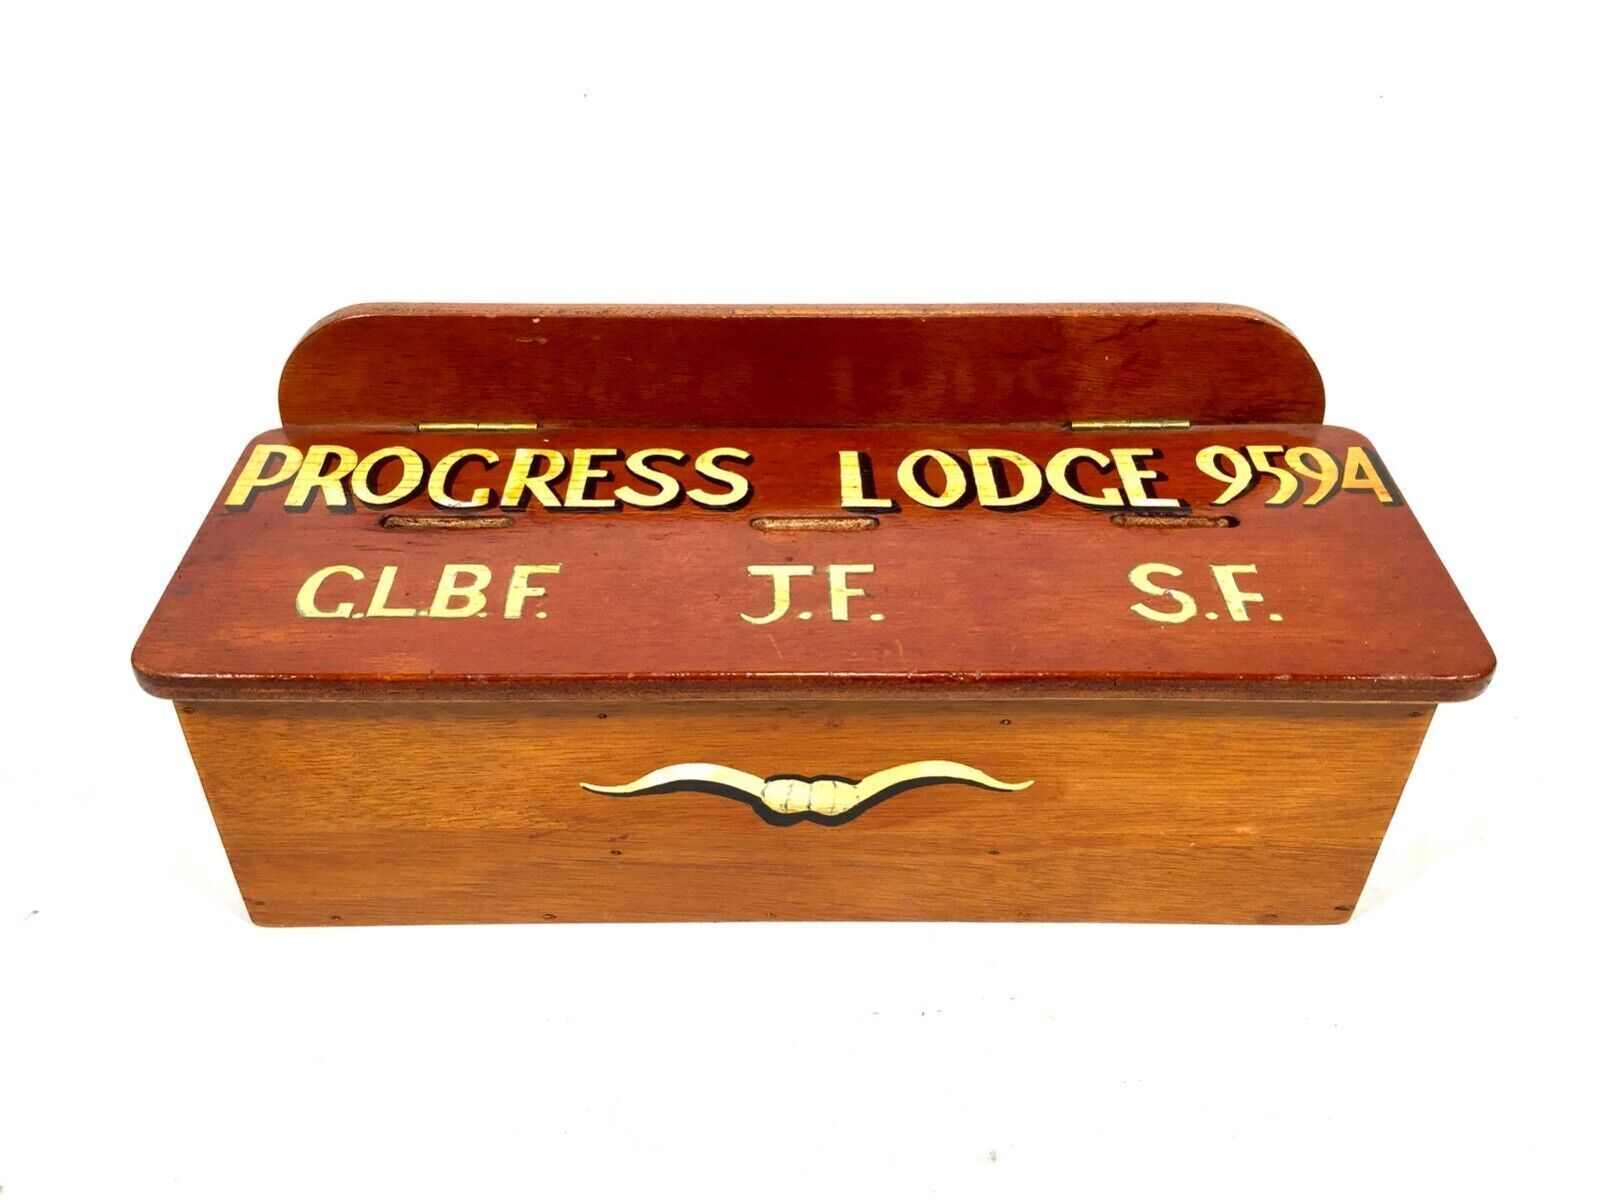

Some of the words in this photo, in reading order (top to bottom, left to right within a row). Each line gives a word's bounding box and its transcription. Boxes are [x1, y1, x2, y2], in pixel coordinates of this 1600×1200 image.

[225, 444, 758, 511] PROGRESS
[839, 447, 1191, 513] LODGE
[1196, 444, 1403, 508] 9594
[740, 564, 885, 626] J.F.
[1129, 562, 1283, 624] S.F.
